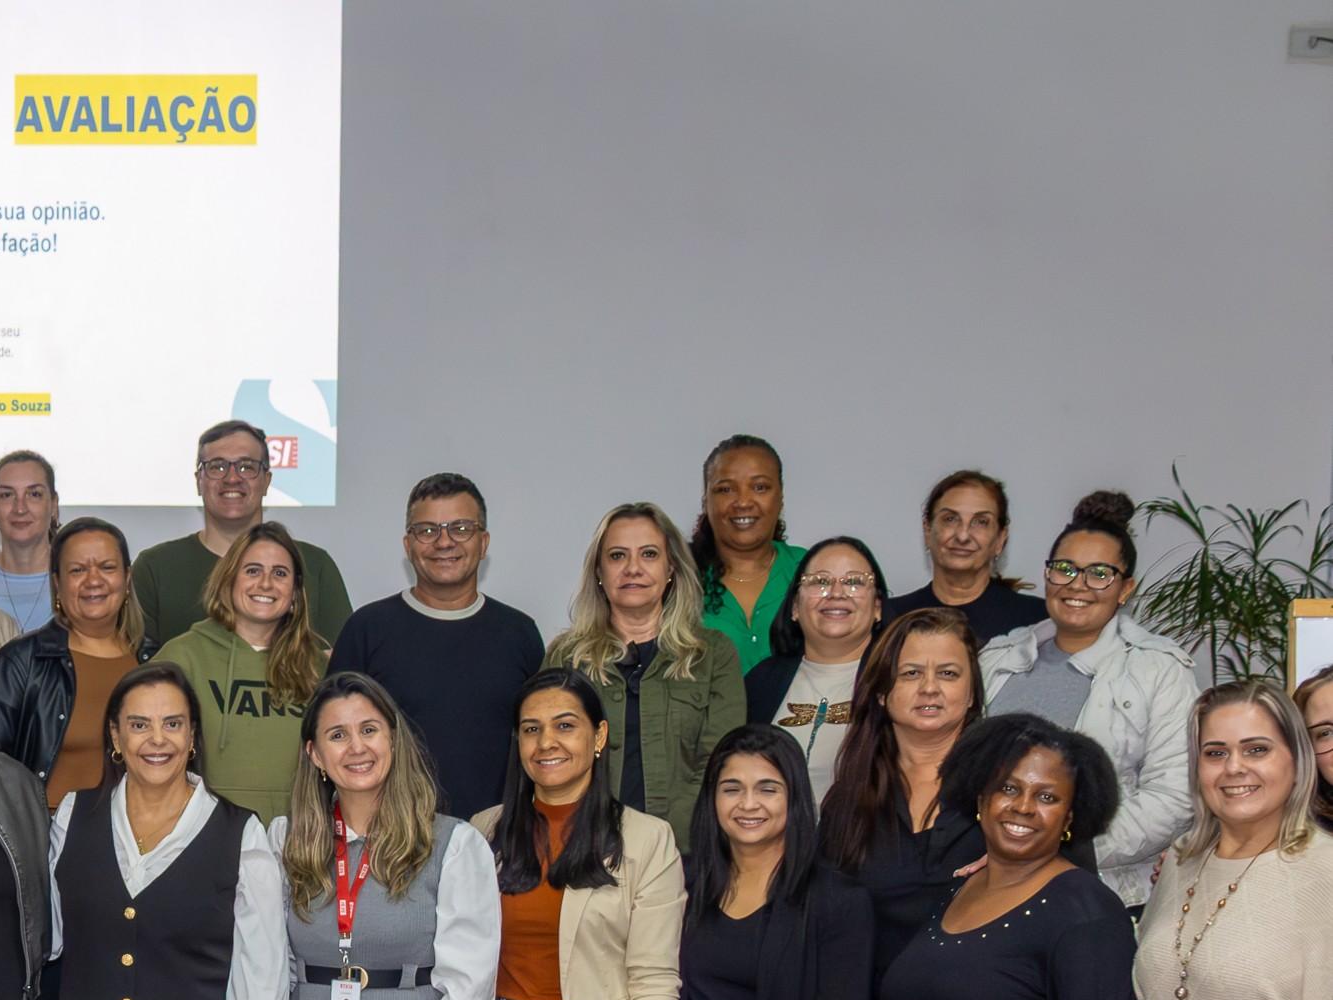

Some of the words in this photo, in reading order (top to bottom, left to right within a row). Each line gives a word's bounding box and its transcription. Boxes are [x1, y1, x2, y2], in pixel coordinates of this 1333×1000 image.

[15, 86, 257, 144] AVALIAÇÃO
[31, 201, 105, 225] opinião.
[1, 327, 21, 338] seu
[11, 399, 51, 412] Souza
